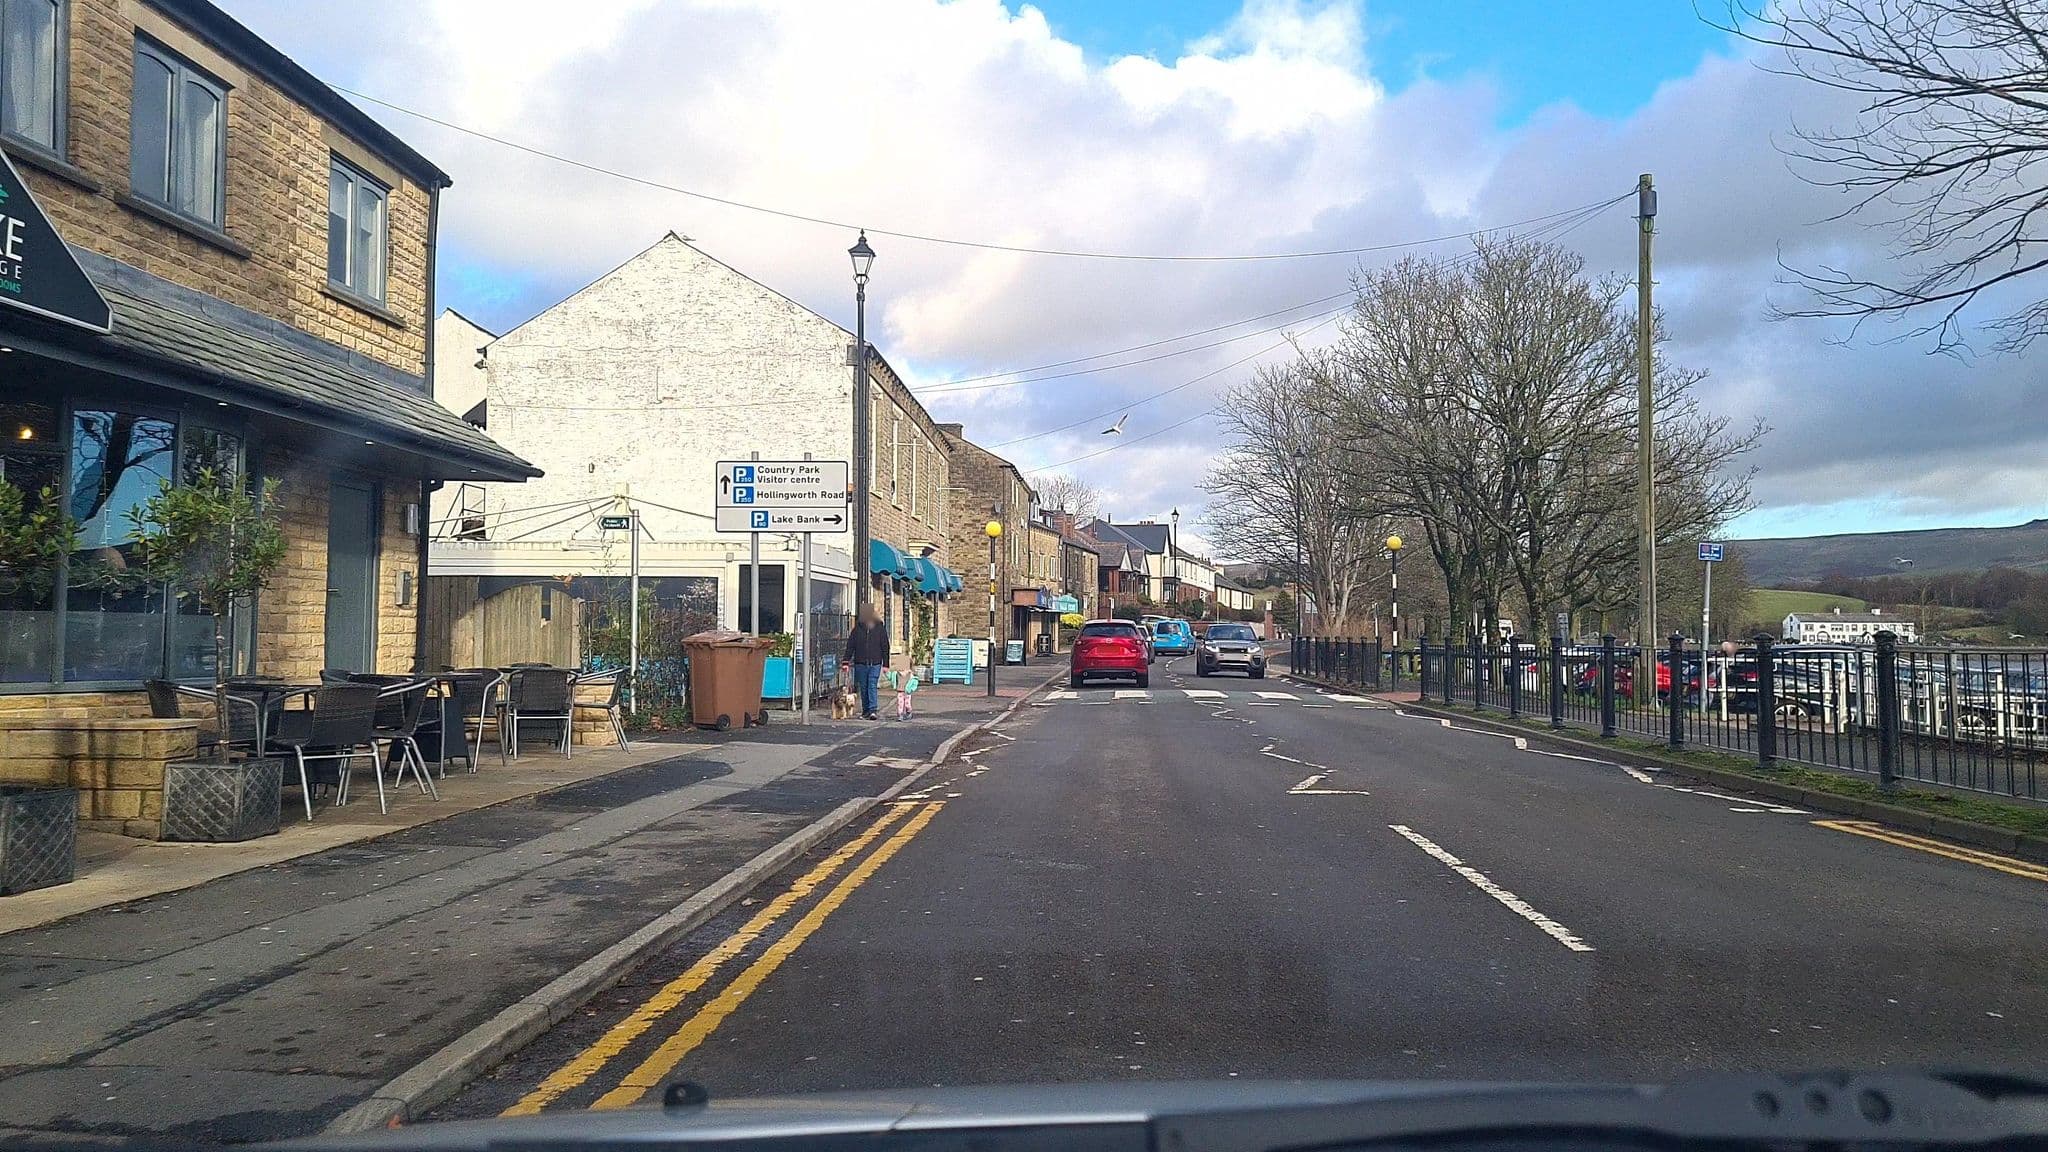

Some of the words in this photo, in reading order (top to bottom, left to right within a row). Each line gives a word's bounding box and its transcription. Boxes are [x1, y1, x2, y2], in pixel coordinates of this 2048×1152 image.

[757, 465, 795, 475] Country
[799, 465, 820, 474] Park
[757, 475, 787, 483] Visitor
[790, 475, 821, 483] centre
[757, 491, 817, 500] Hollingworth
[820, 491, 844, 499] Road
[771, 515, 794, 523] Lake
[797, 515, 820, 523] Bank
